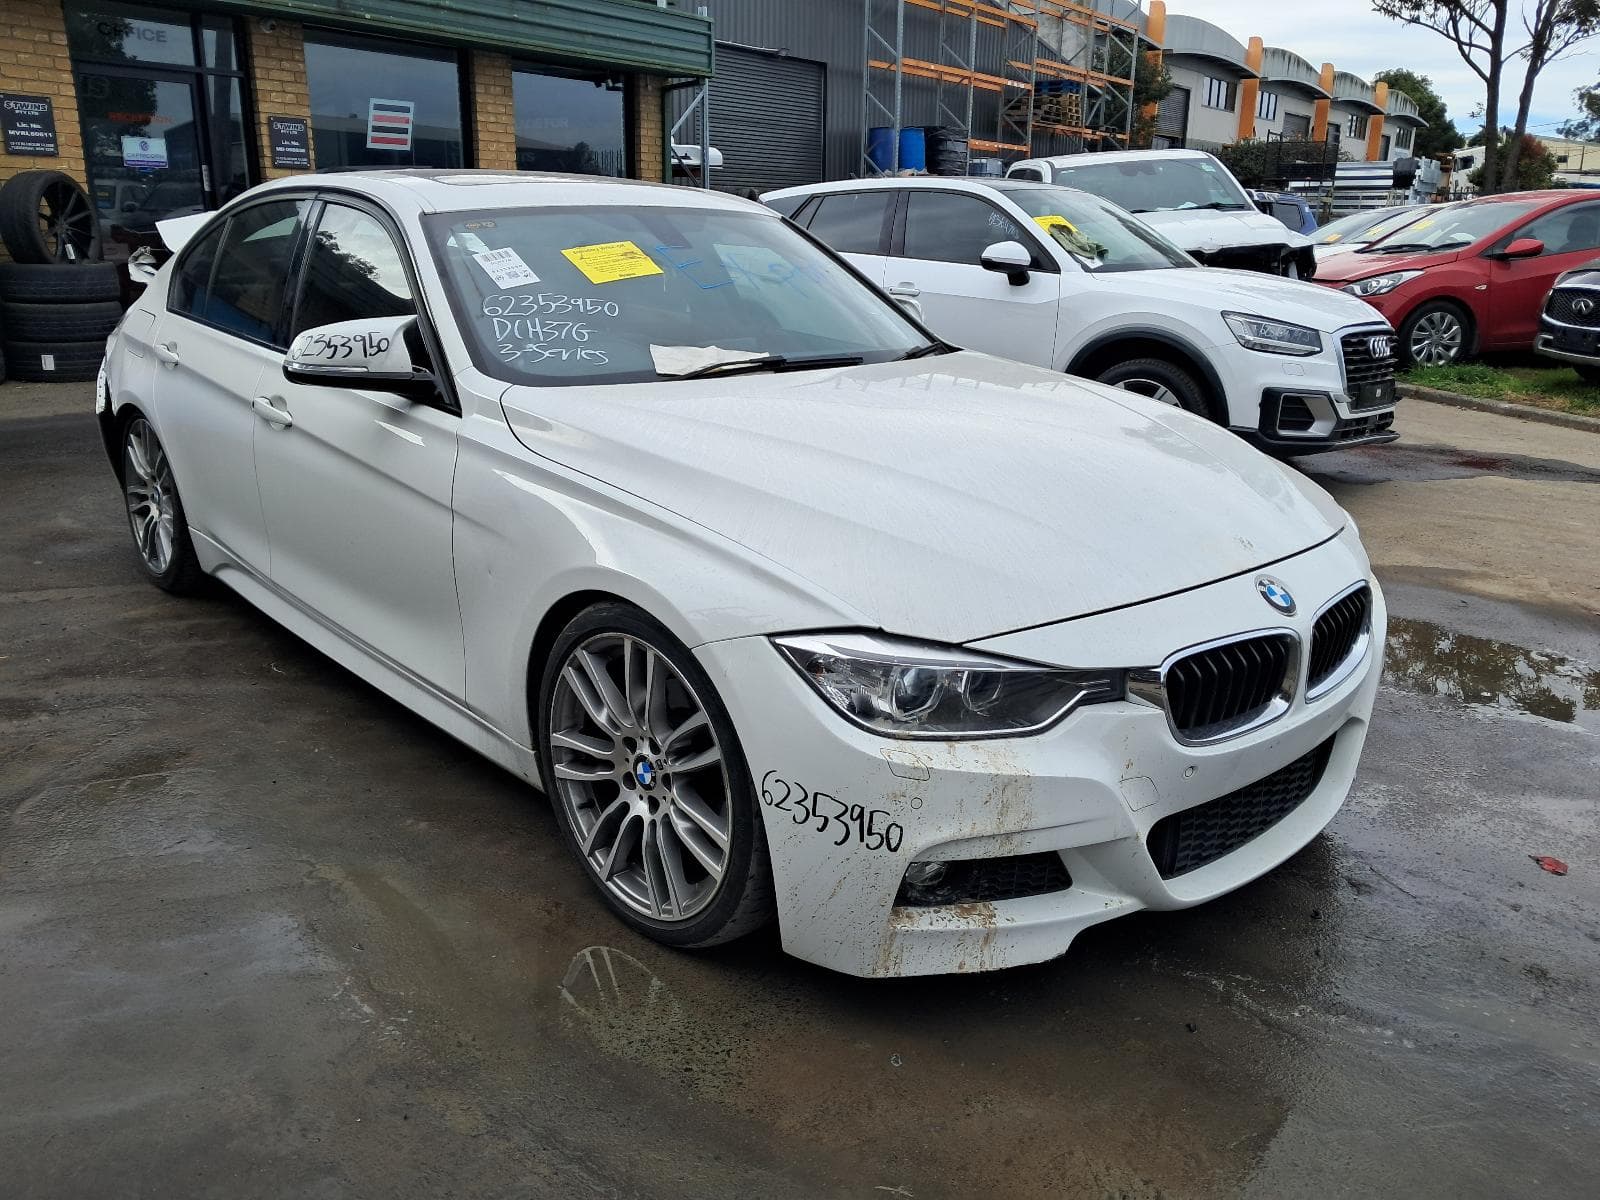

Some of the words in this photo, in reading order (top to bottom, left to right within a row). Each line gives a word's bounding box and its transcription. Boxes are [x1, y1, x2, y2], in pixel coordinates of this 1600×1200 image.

[97, 21, 168, 43] OFFICE
[483, 293, 619, 318] 62353950
[761, 769, 904, 853] 62353950
